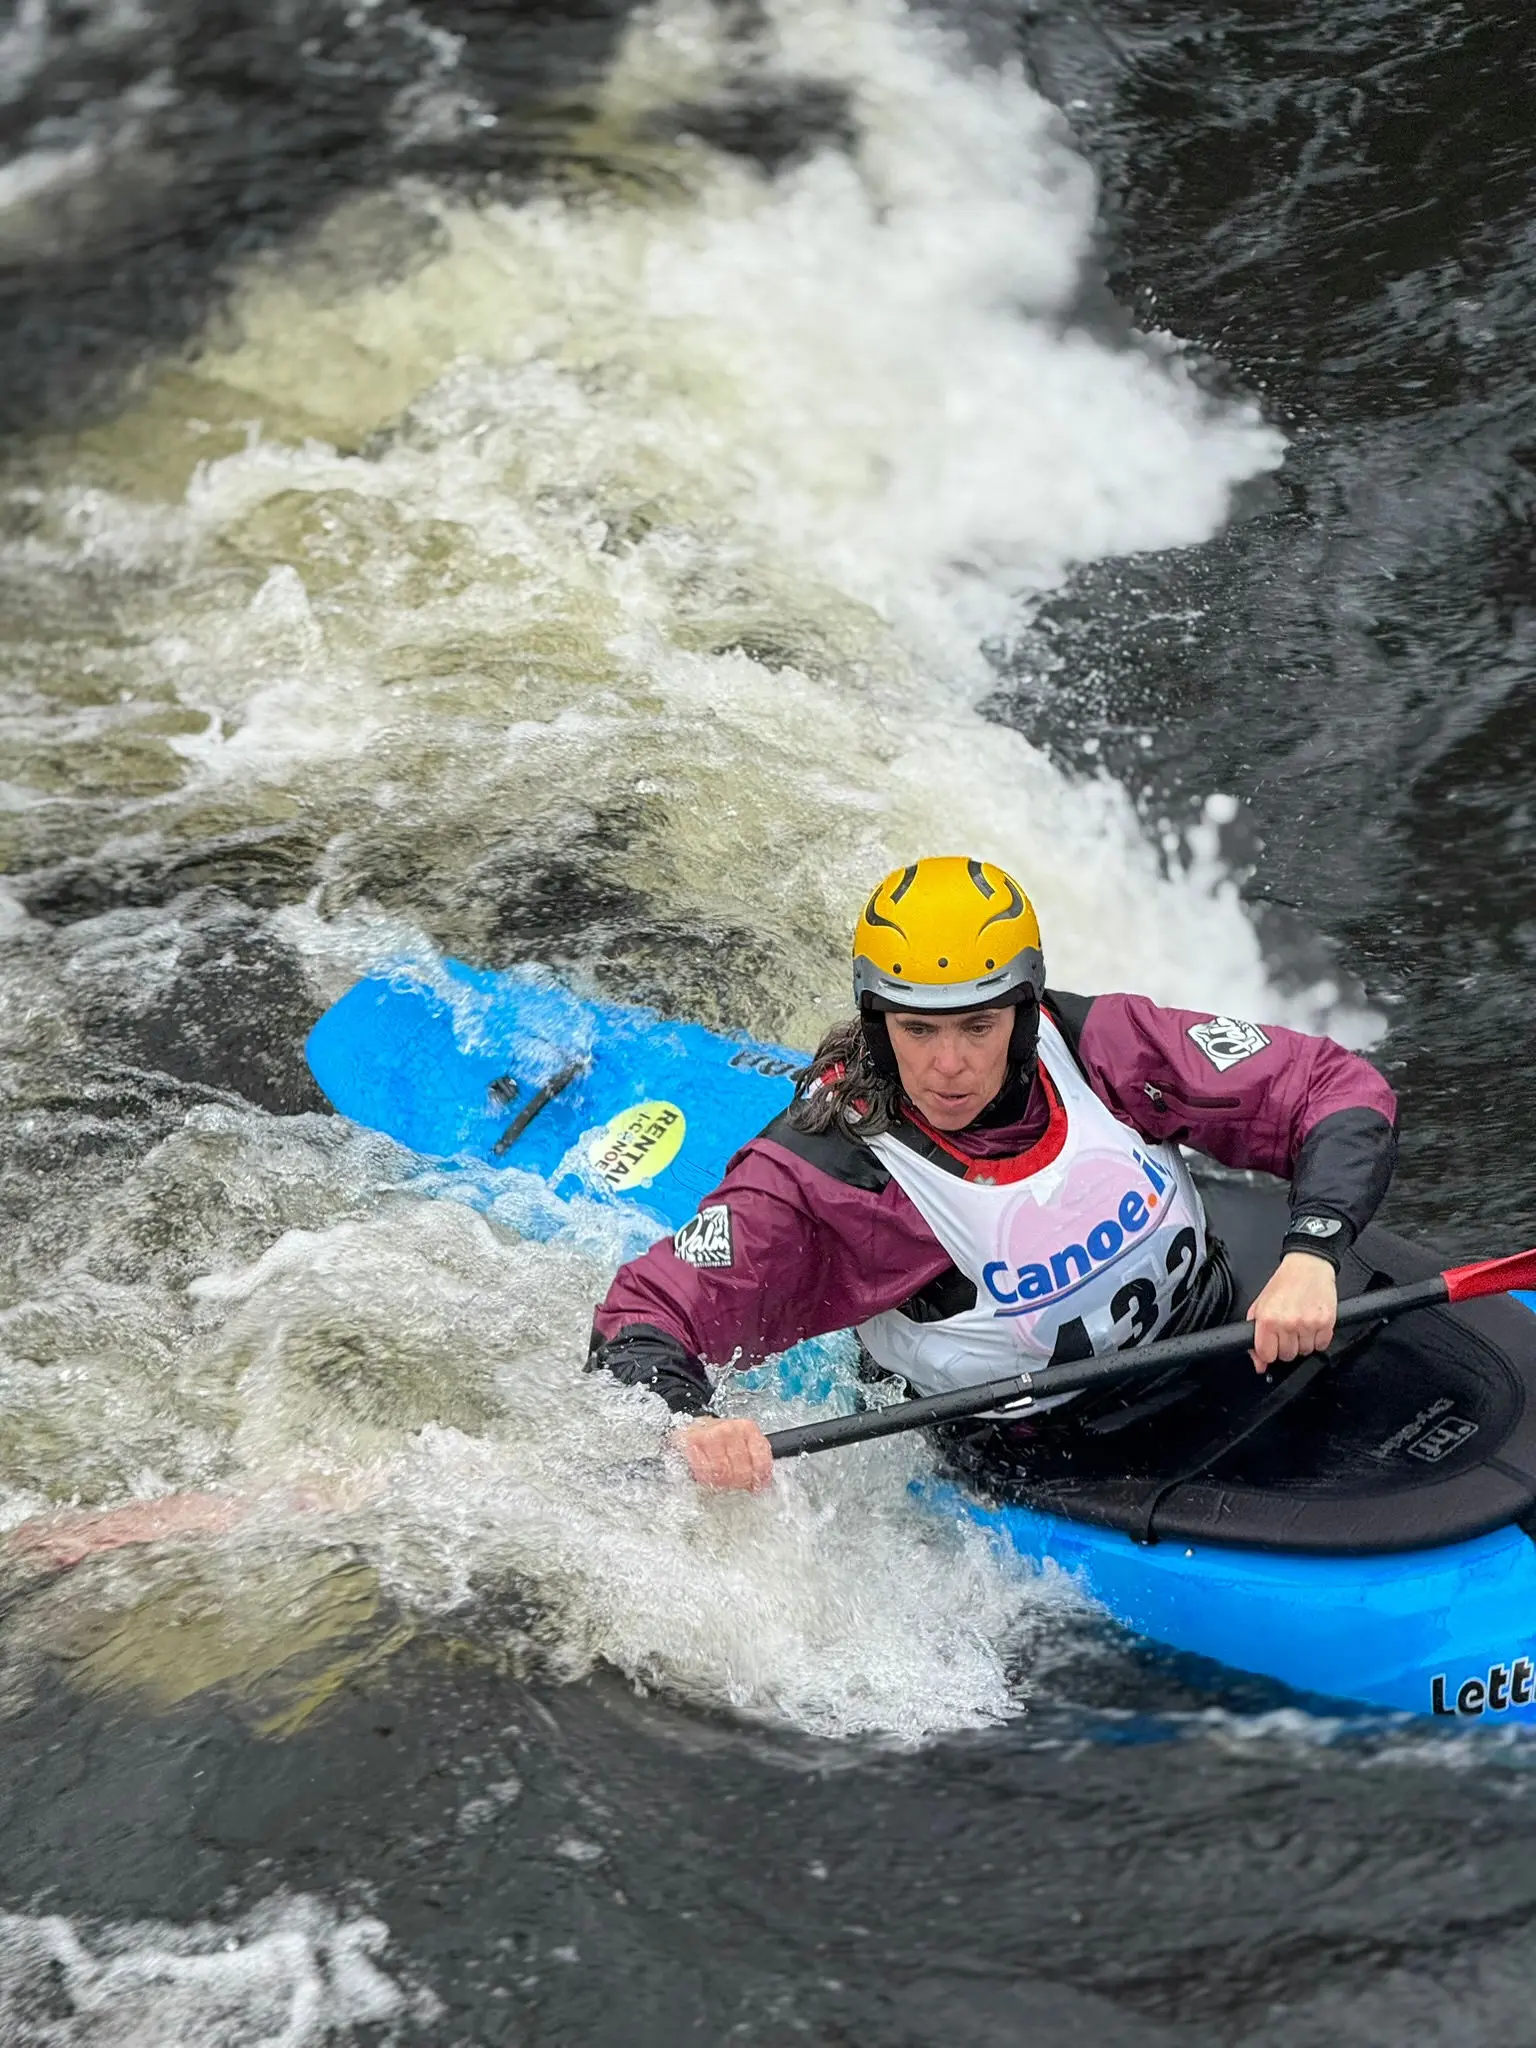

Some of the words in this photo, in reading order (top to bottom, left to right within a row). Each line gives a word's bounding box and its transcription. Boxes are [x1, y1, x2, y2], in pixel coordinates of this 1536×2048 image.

[604, 1109, 679, 1184] RENTAL
[675, 1212, 731, 1260] Palm
[1431, 1656, 1536, 1716] Lett
